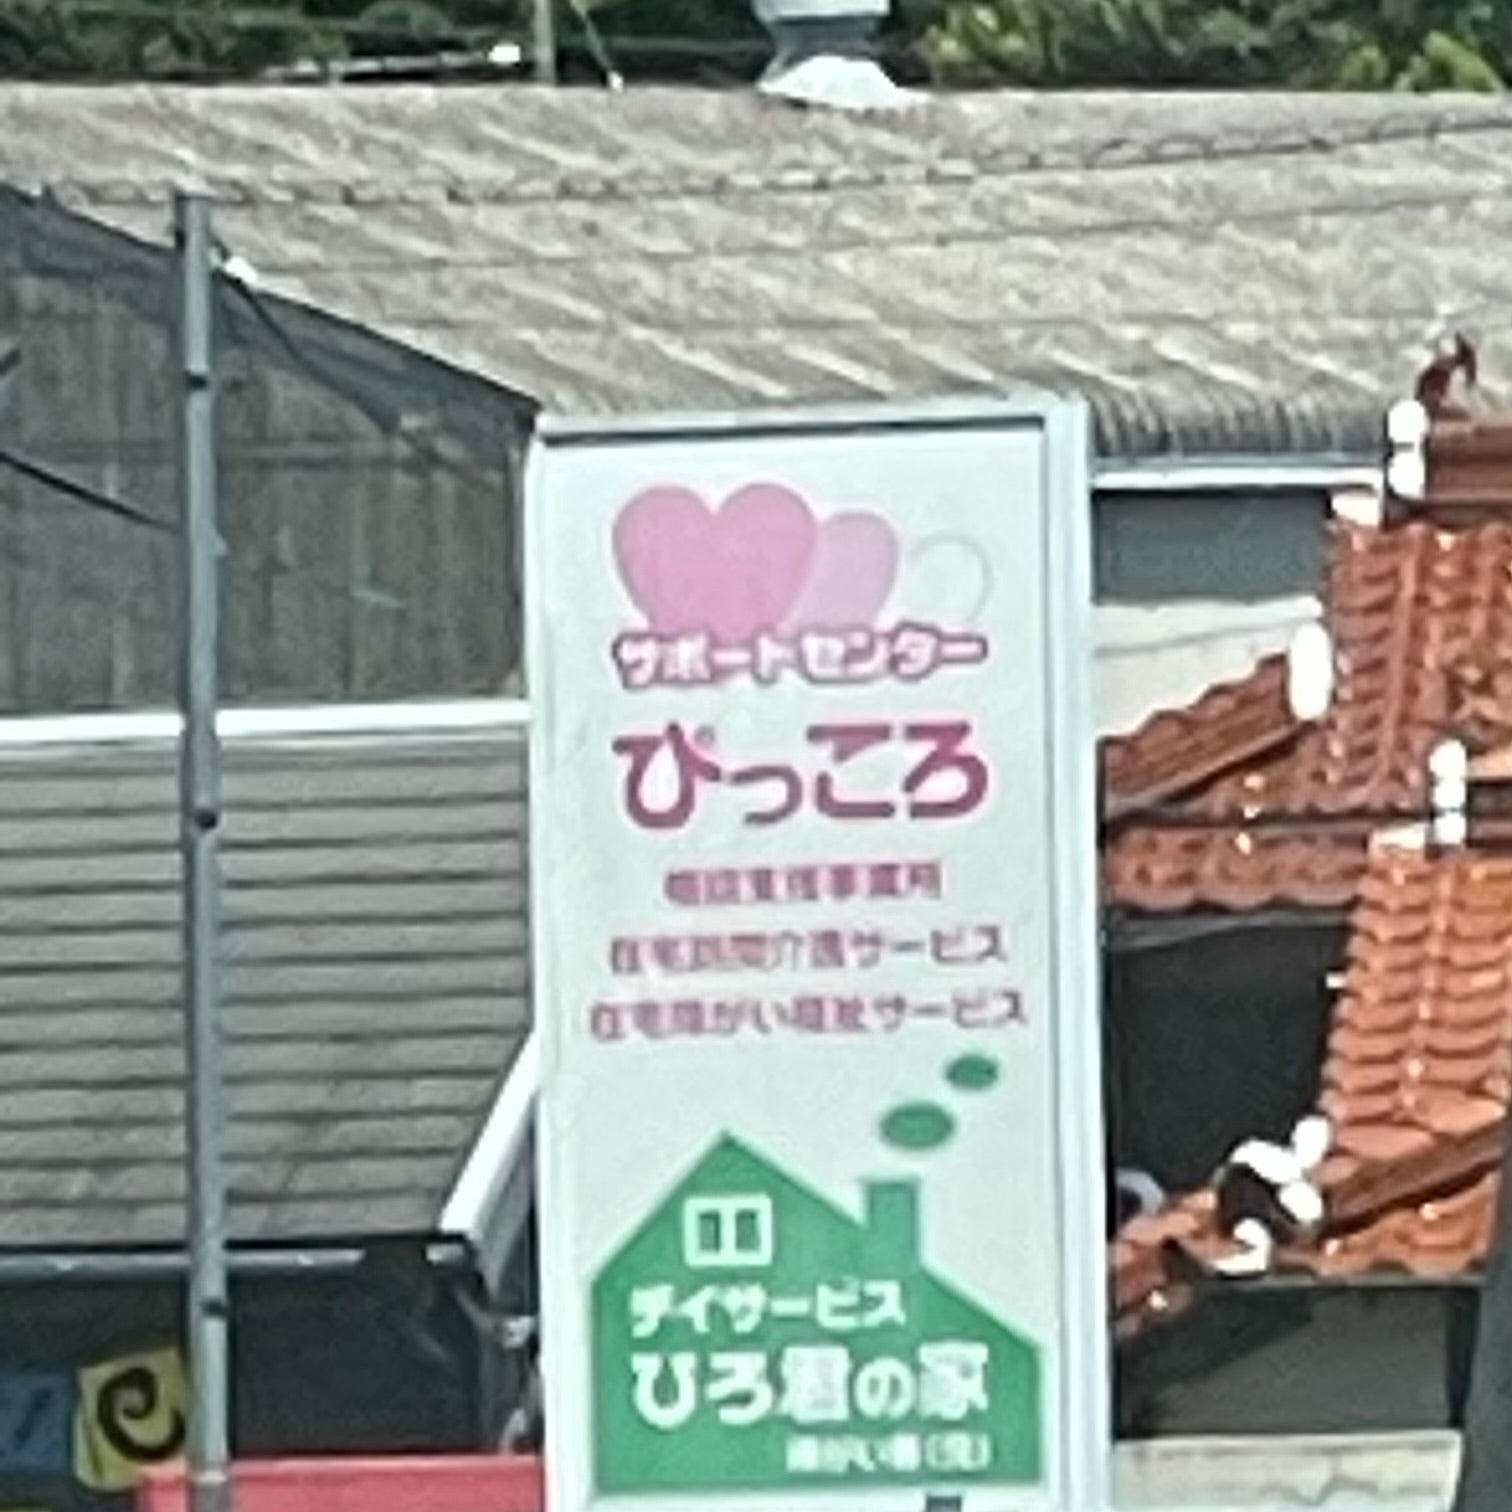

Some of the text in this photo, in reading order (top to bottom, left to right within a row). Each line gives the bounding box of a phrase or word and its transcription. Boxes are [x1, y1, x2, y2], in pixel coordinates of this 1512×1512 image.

[612, 623, 987, 690] サポートセンター
[612, 722, 989, 829] ぴっころ
[630, 1278, 906, 1337] デイサービス
